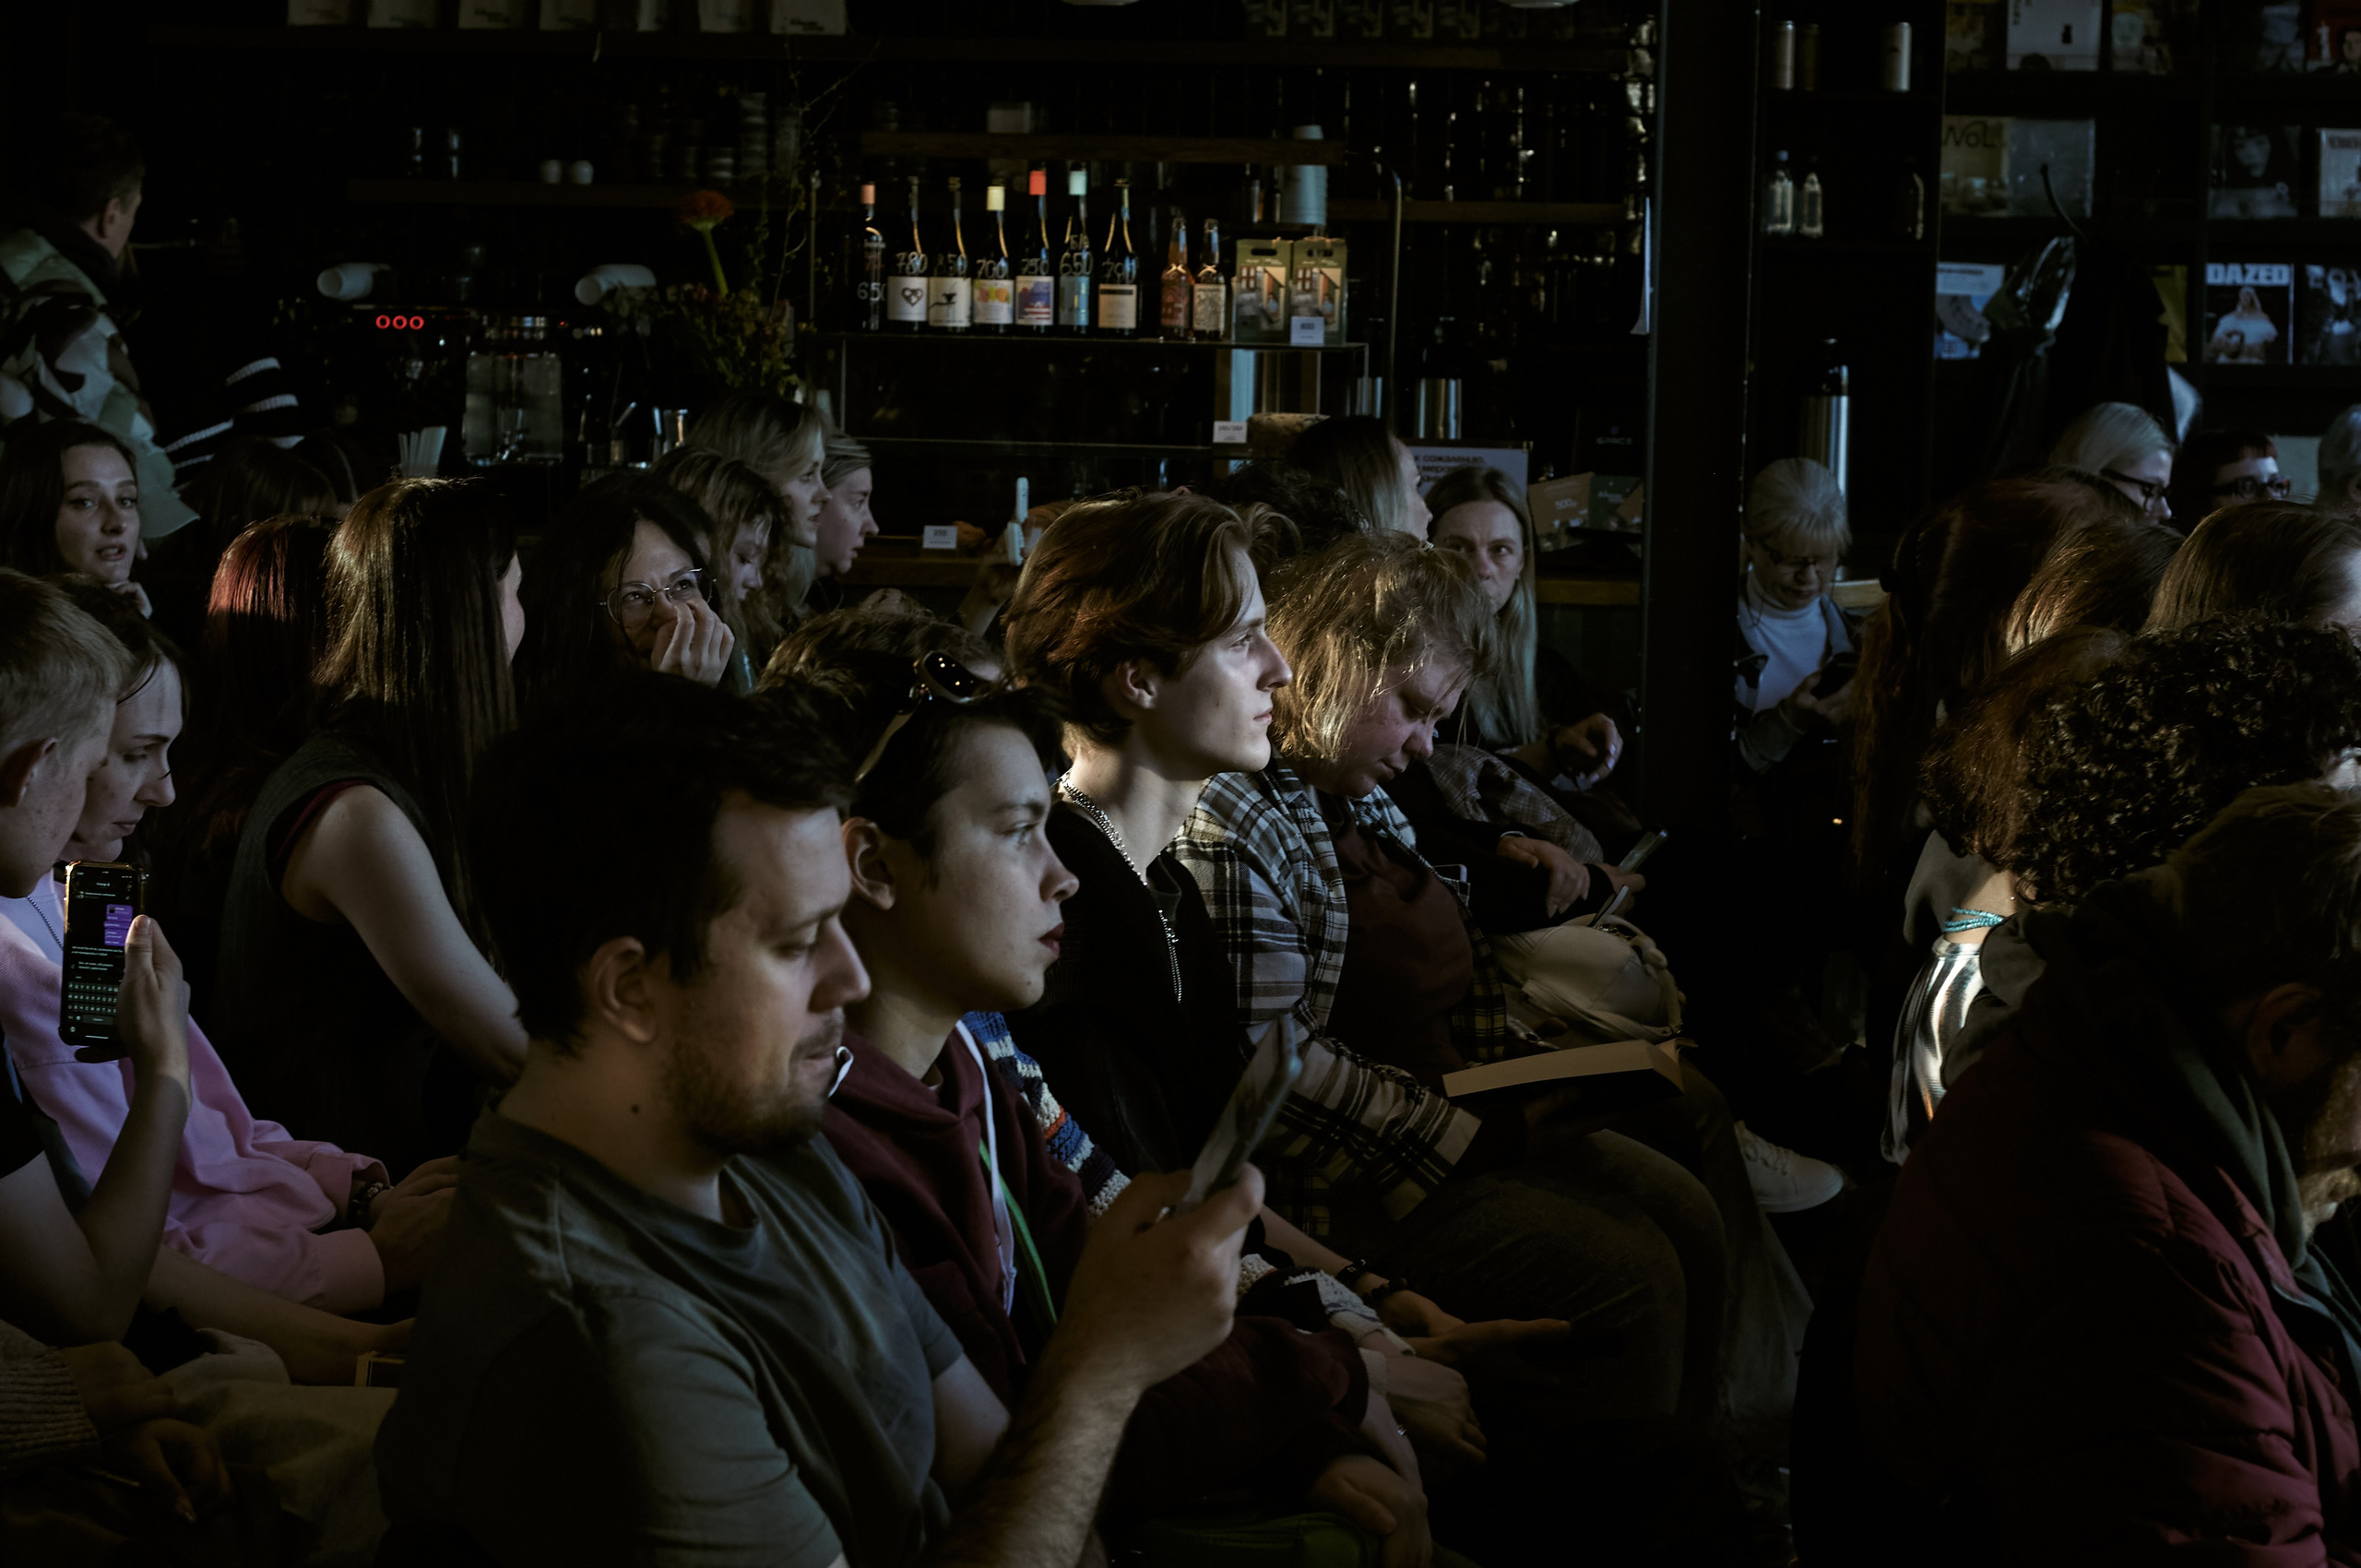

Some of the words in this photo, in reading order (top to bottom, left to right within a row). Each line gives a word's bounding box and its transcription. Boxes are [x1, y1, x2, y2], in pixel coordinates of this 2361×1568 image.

[895, 251, 929, 276] 780
[1060, 251, 1095, 277] 650
[2205, 262, 2290, 287] DAZED
